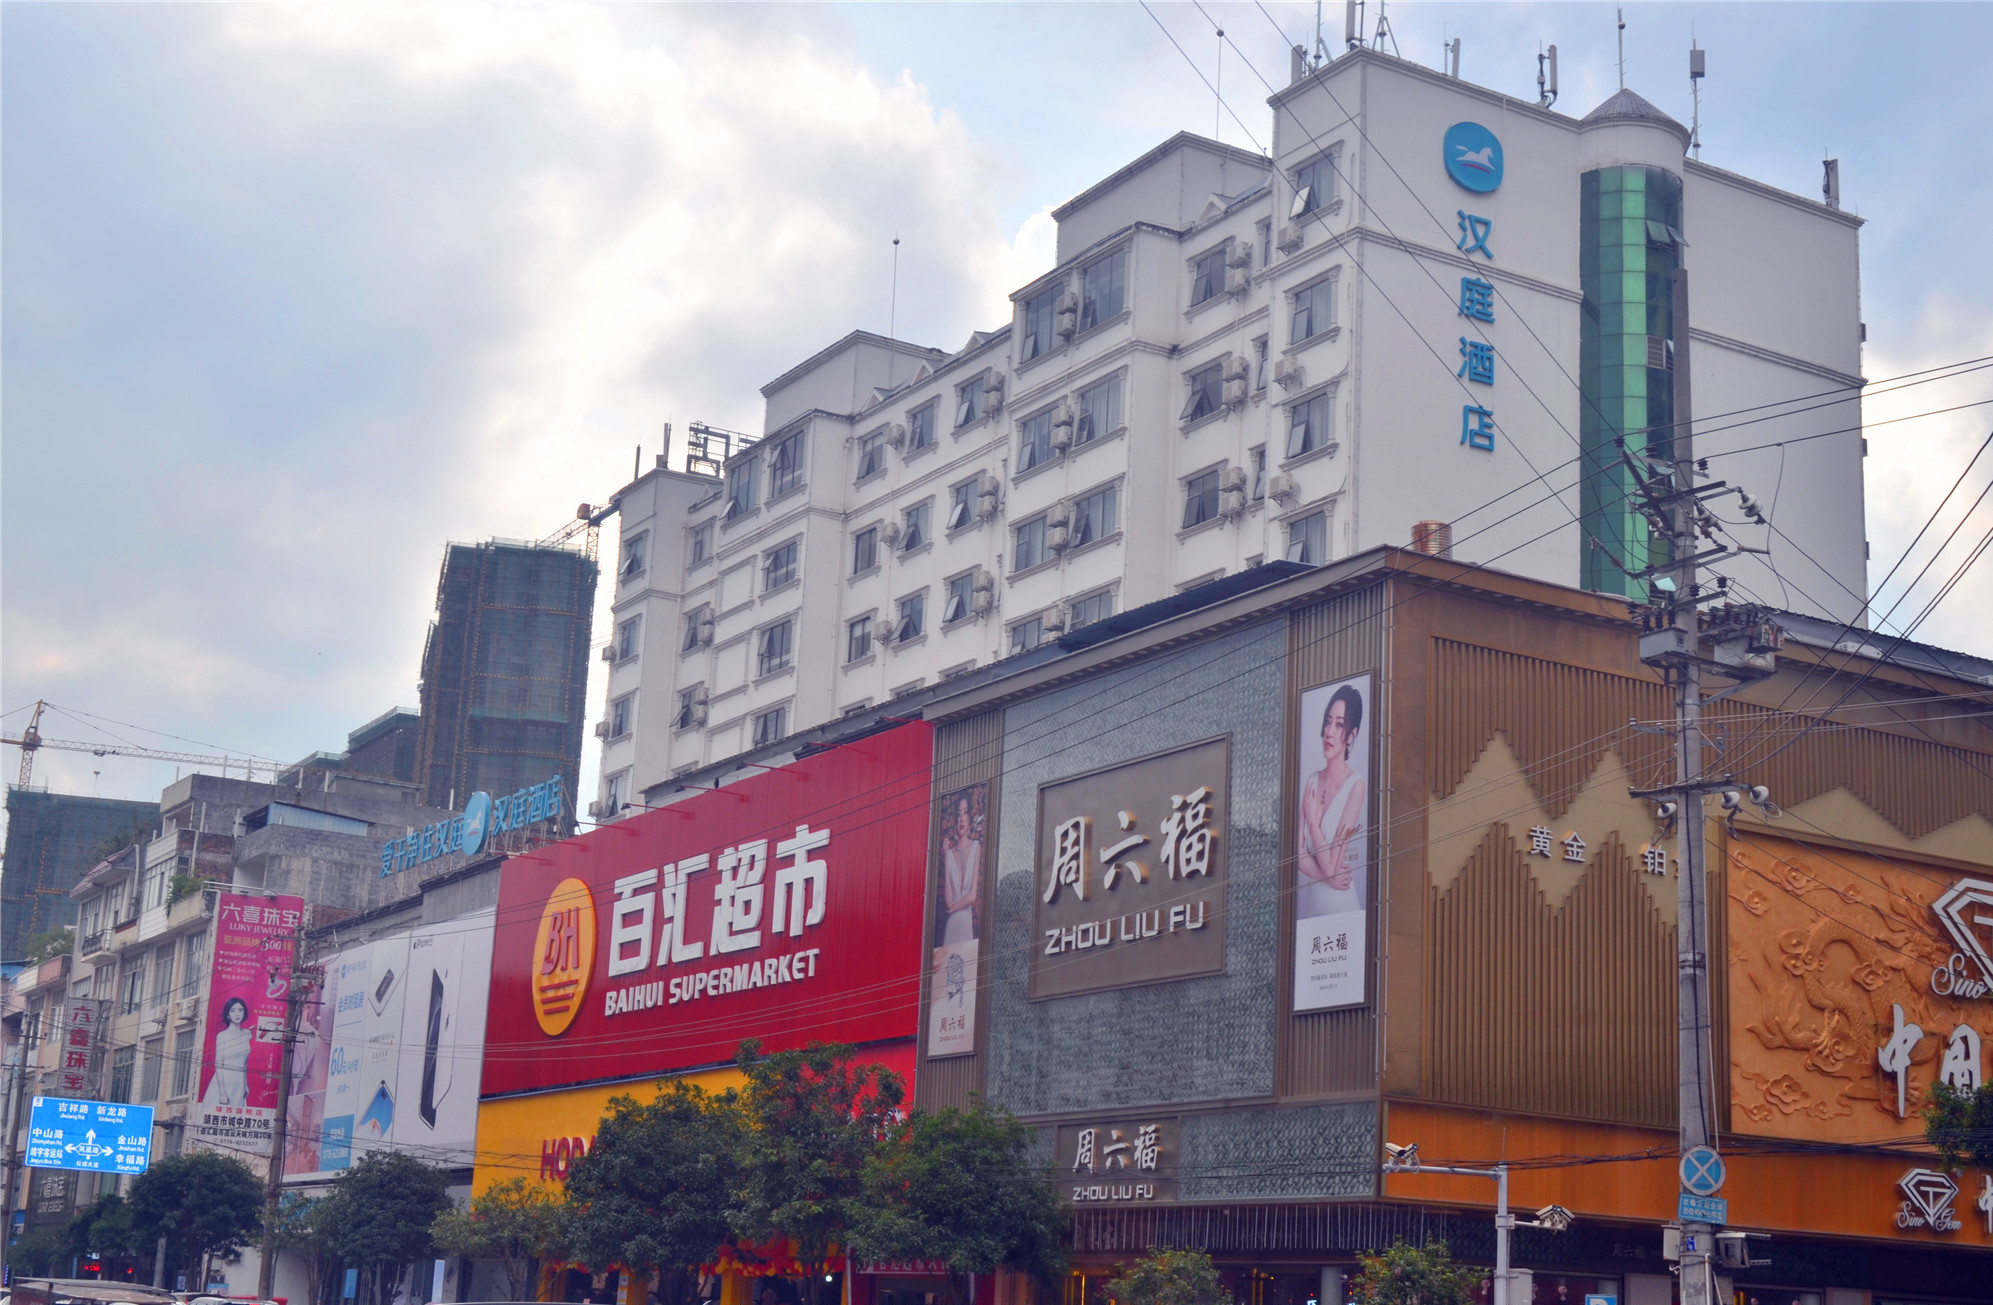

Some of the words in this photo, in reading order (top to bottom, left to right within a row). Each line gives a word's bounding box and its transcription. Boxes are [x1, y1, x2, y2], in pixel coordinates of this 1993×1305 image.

[1457, 209, 1495, 452] 汉庭酒店
[492, 774, 562, 836] 汉庭酒店
[1042, 785, 1215, 904] 周六福
[1528, 825, 1587, 862] 黄金
[1643, 844, 1678, 878] 铂
[221, 903, 300, 927] 六喜珠宝
[608, 825, 831, 977] 百汇超市
[229, 922, 252, 932] LUKY
[253, 925, 289, 936] JEWELRY
[541, 905, 580, 975] BH
[1044, 918, 1111, 955] ZHOU
[1120, 909, 1159, 941] LIU
[1168, 901, 1204, 932] FU
[1311, 933, 1348, 954] 周六福
[604, 980, 664, 1016] BAIHUI
[668, 948, 820, 1004] SUPERMARKET
[1931, 953, 1986, 999] Sino
[63, 1005, 93, 1090] 六喜珠宝
[58, 1102, 89, 1114] 吉祥路
[96, 1105, 127, 1117] 新龙路
[203, 1114, 270, 1129] 靖西市城中路70号
[30, 1147, 63, 1158] 靖宇客运站
[32, 1127, 64, 1139] 中山路
[117, 1134, 147, 1146] 金山路
[1072, 1123, 1159, 1174] 周六福
[115, 1154, 145, 1165] 幸福路
[540, 1135, 599, 1181] HOD
[1073, 1185, 1108, 1201] ZHOU
[1111, 1184, 1132, 1200] LIU
[1135, 1184, 1153, 1199] FU
[1897, 1201, 1926, 1228] Sino
[1935, 1208, 1963, 1231] Gem
